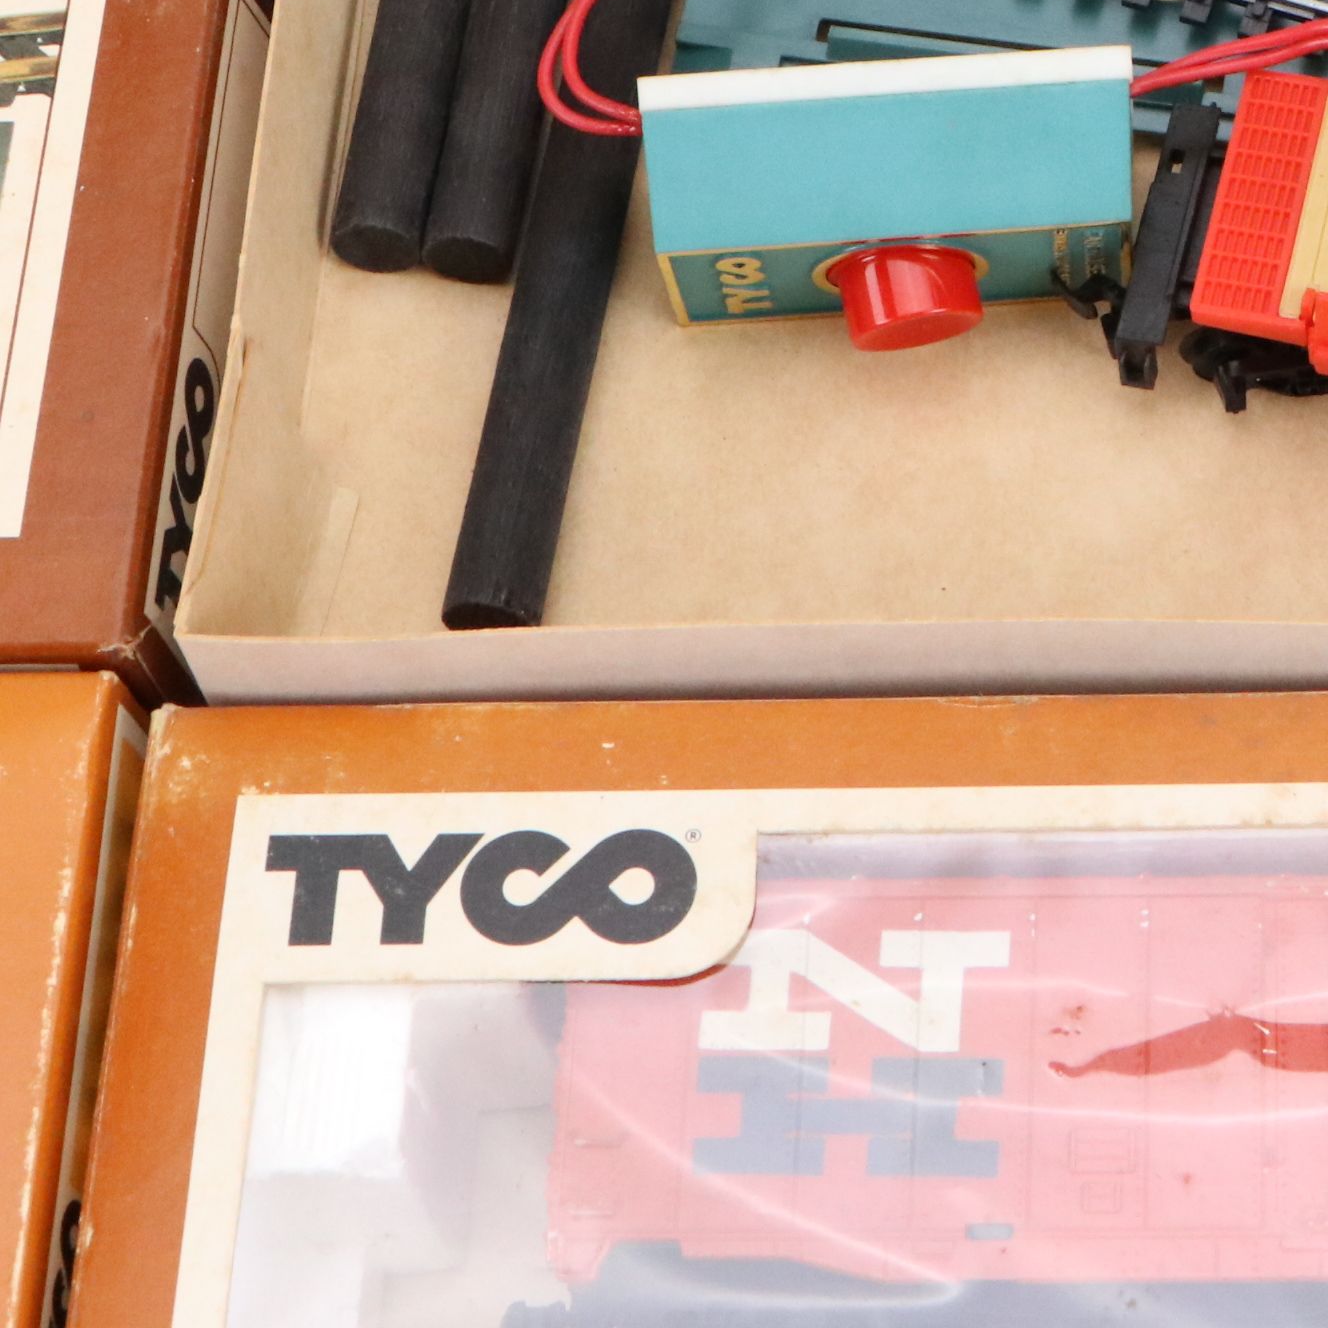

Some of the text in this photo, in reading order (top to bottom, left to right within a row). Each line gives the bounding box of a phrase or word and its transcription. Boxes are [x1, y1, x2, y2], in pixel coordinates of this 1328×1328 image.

[715, 256, 773, 314] TYCO
[265, 828, 698, 947] TYCO
[698, 929, 1011, 1053] N
[691, 1056, 1005, 1179] H
